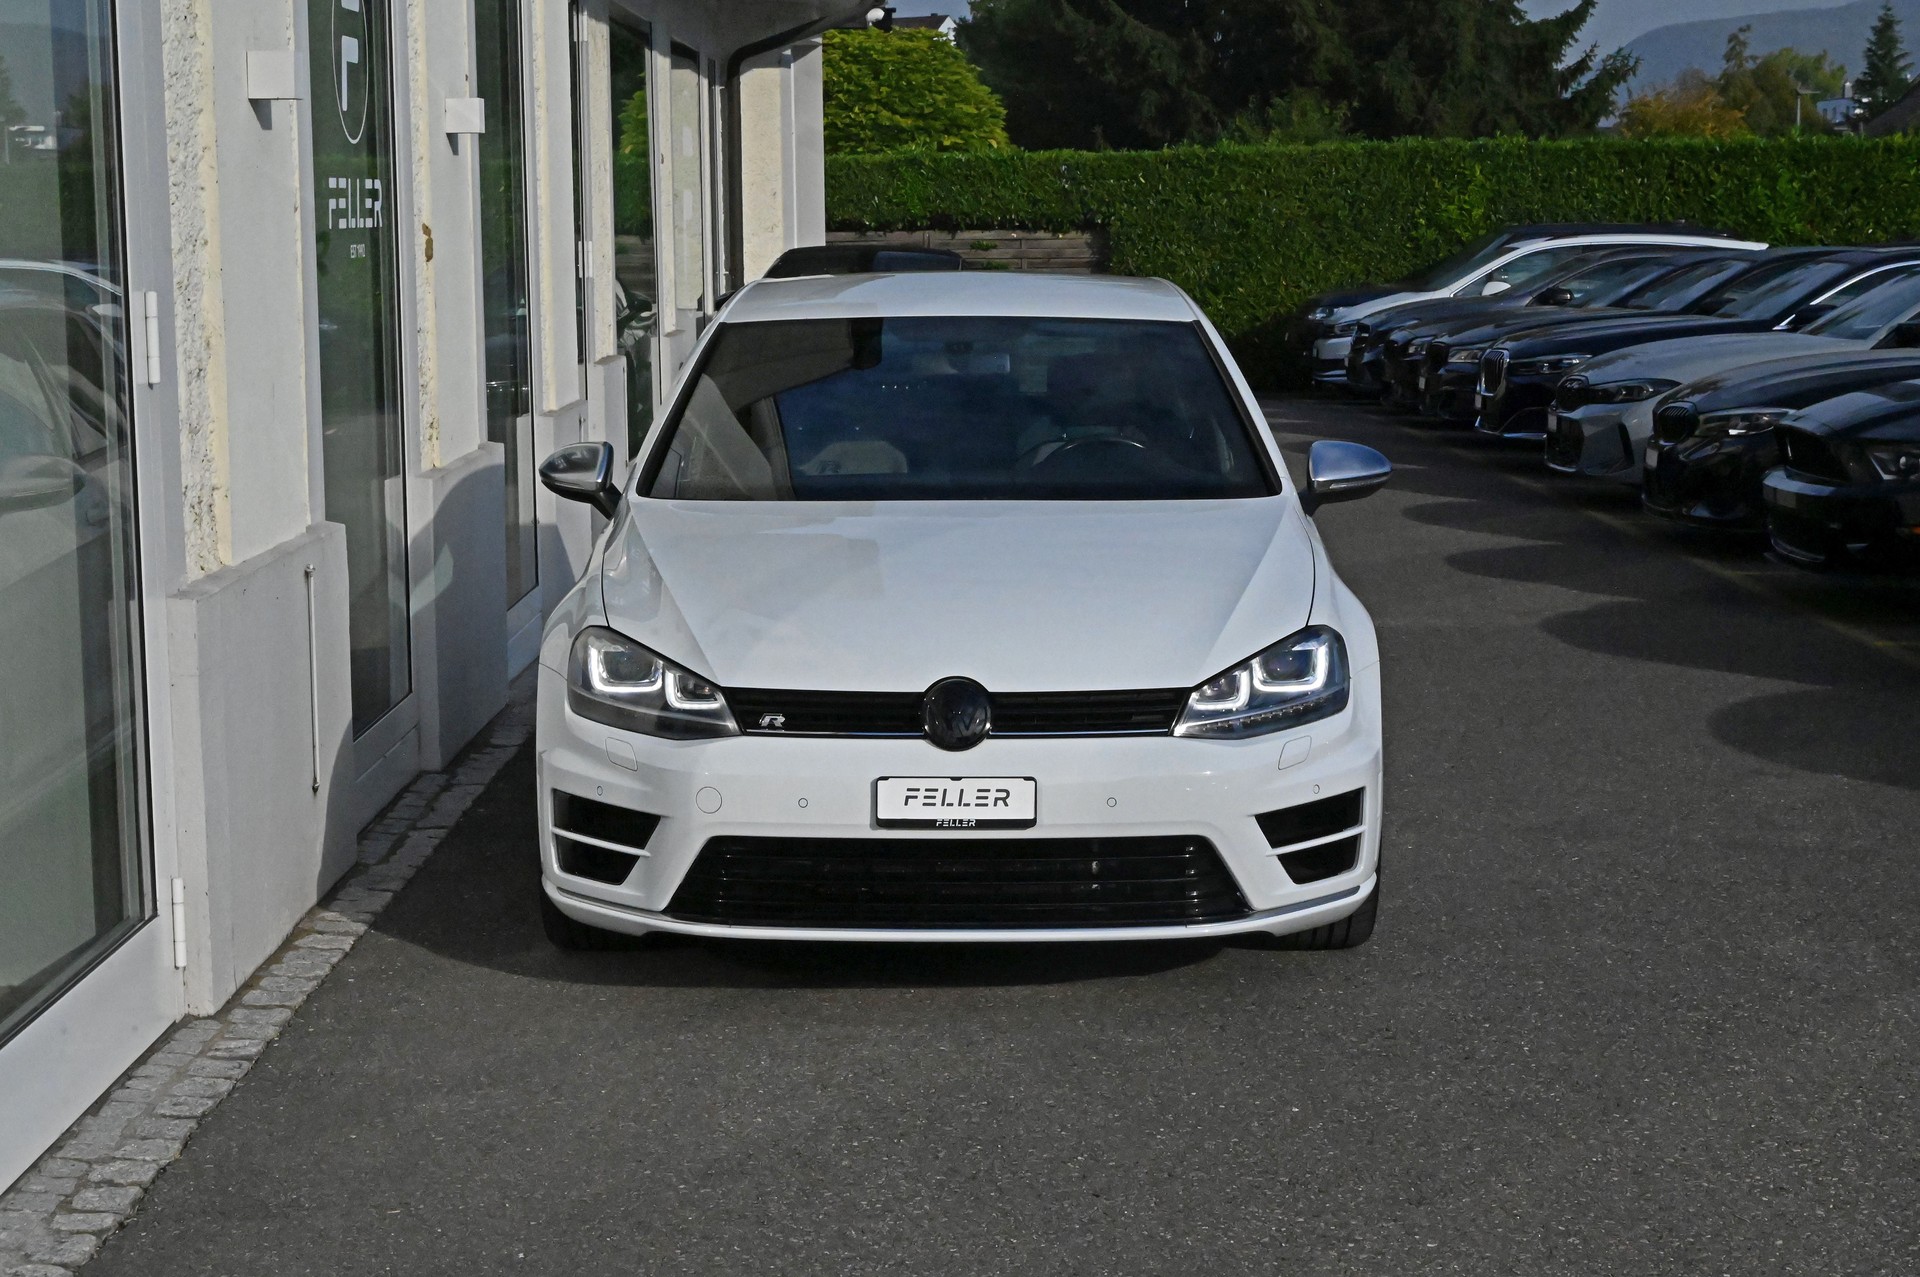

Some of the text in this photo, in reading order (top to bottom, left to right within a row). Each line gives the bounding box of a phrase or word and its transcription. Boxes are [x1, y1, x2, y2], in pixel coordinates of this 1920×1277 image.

[328, 177, 382, 229] FELLER
[759, 713, 785, 727] R
[904, 787, 1011, 807] FELLER
[935, 818, 976, 827] FELLER
